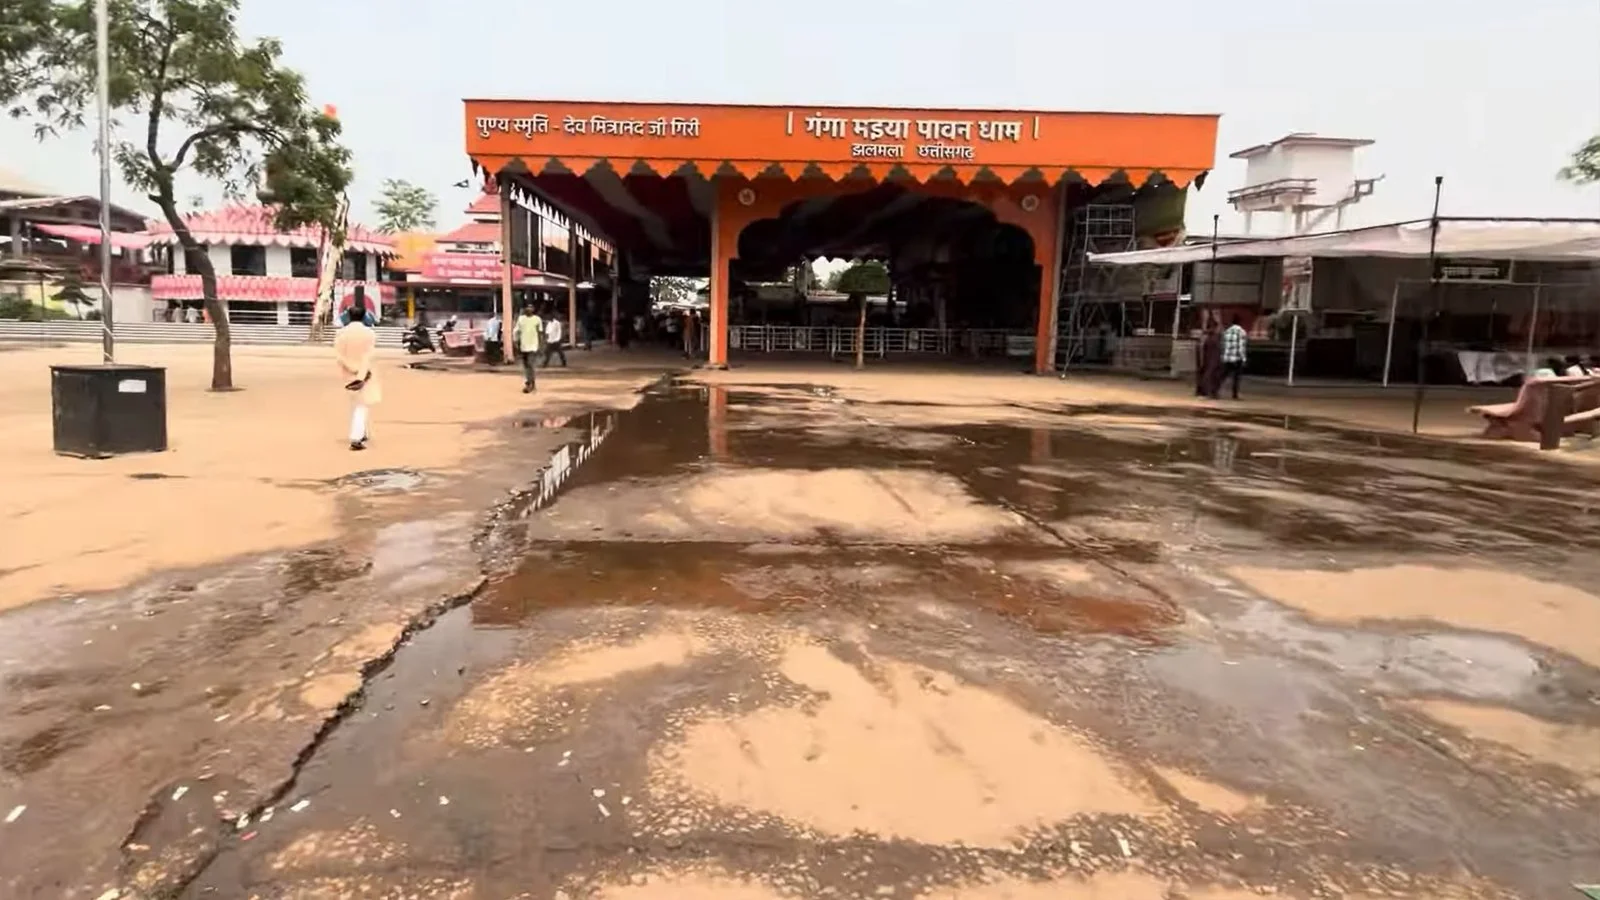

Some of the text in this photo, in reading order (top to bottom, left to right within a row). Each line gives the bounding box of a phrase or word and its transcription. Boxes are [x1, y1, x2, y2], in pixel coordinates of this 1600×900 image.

[476, 117, 510, 139] पुण्य
[512, 113, 549, 139] स्मृति
[563, 115, 586, 134] देव
[590, 115, 645, 136] मित्रानंद
[647, 117, 667, 137] जी
[670, 117, 700, 137] गिरी
[805, 111, 848, 138] गंगा
[852, 118, 911, 140] मइया
[916, 119, 974, 141] पावन
[978, 120, 1023, 142] धाम
[852, 143, 904, 158] झलमला
